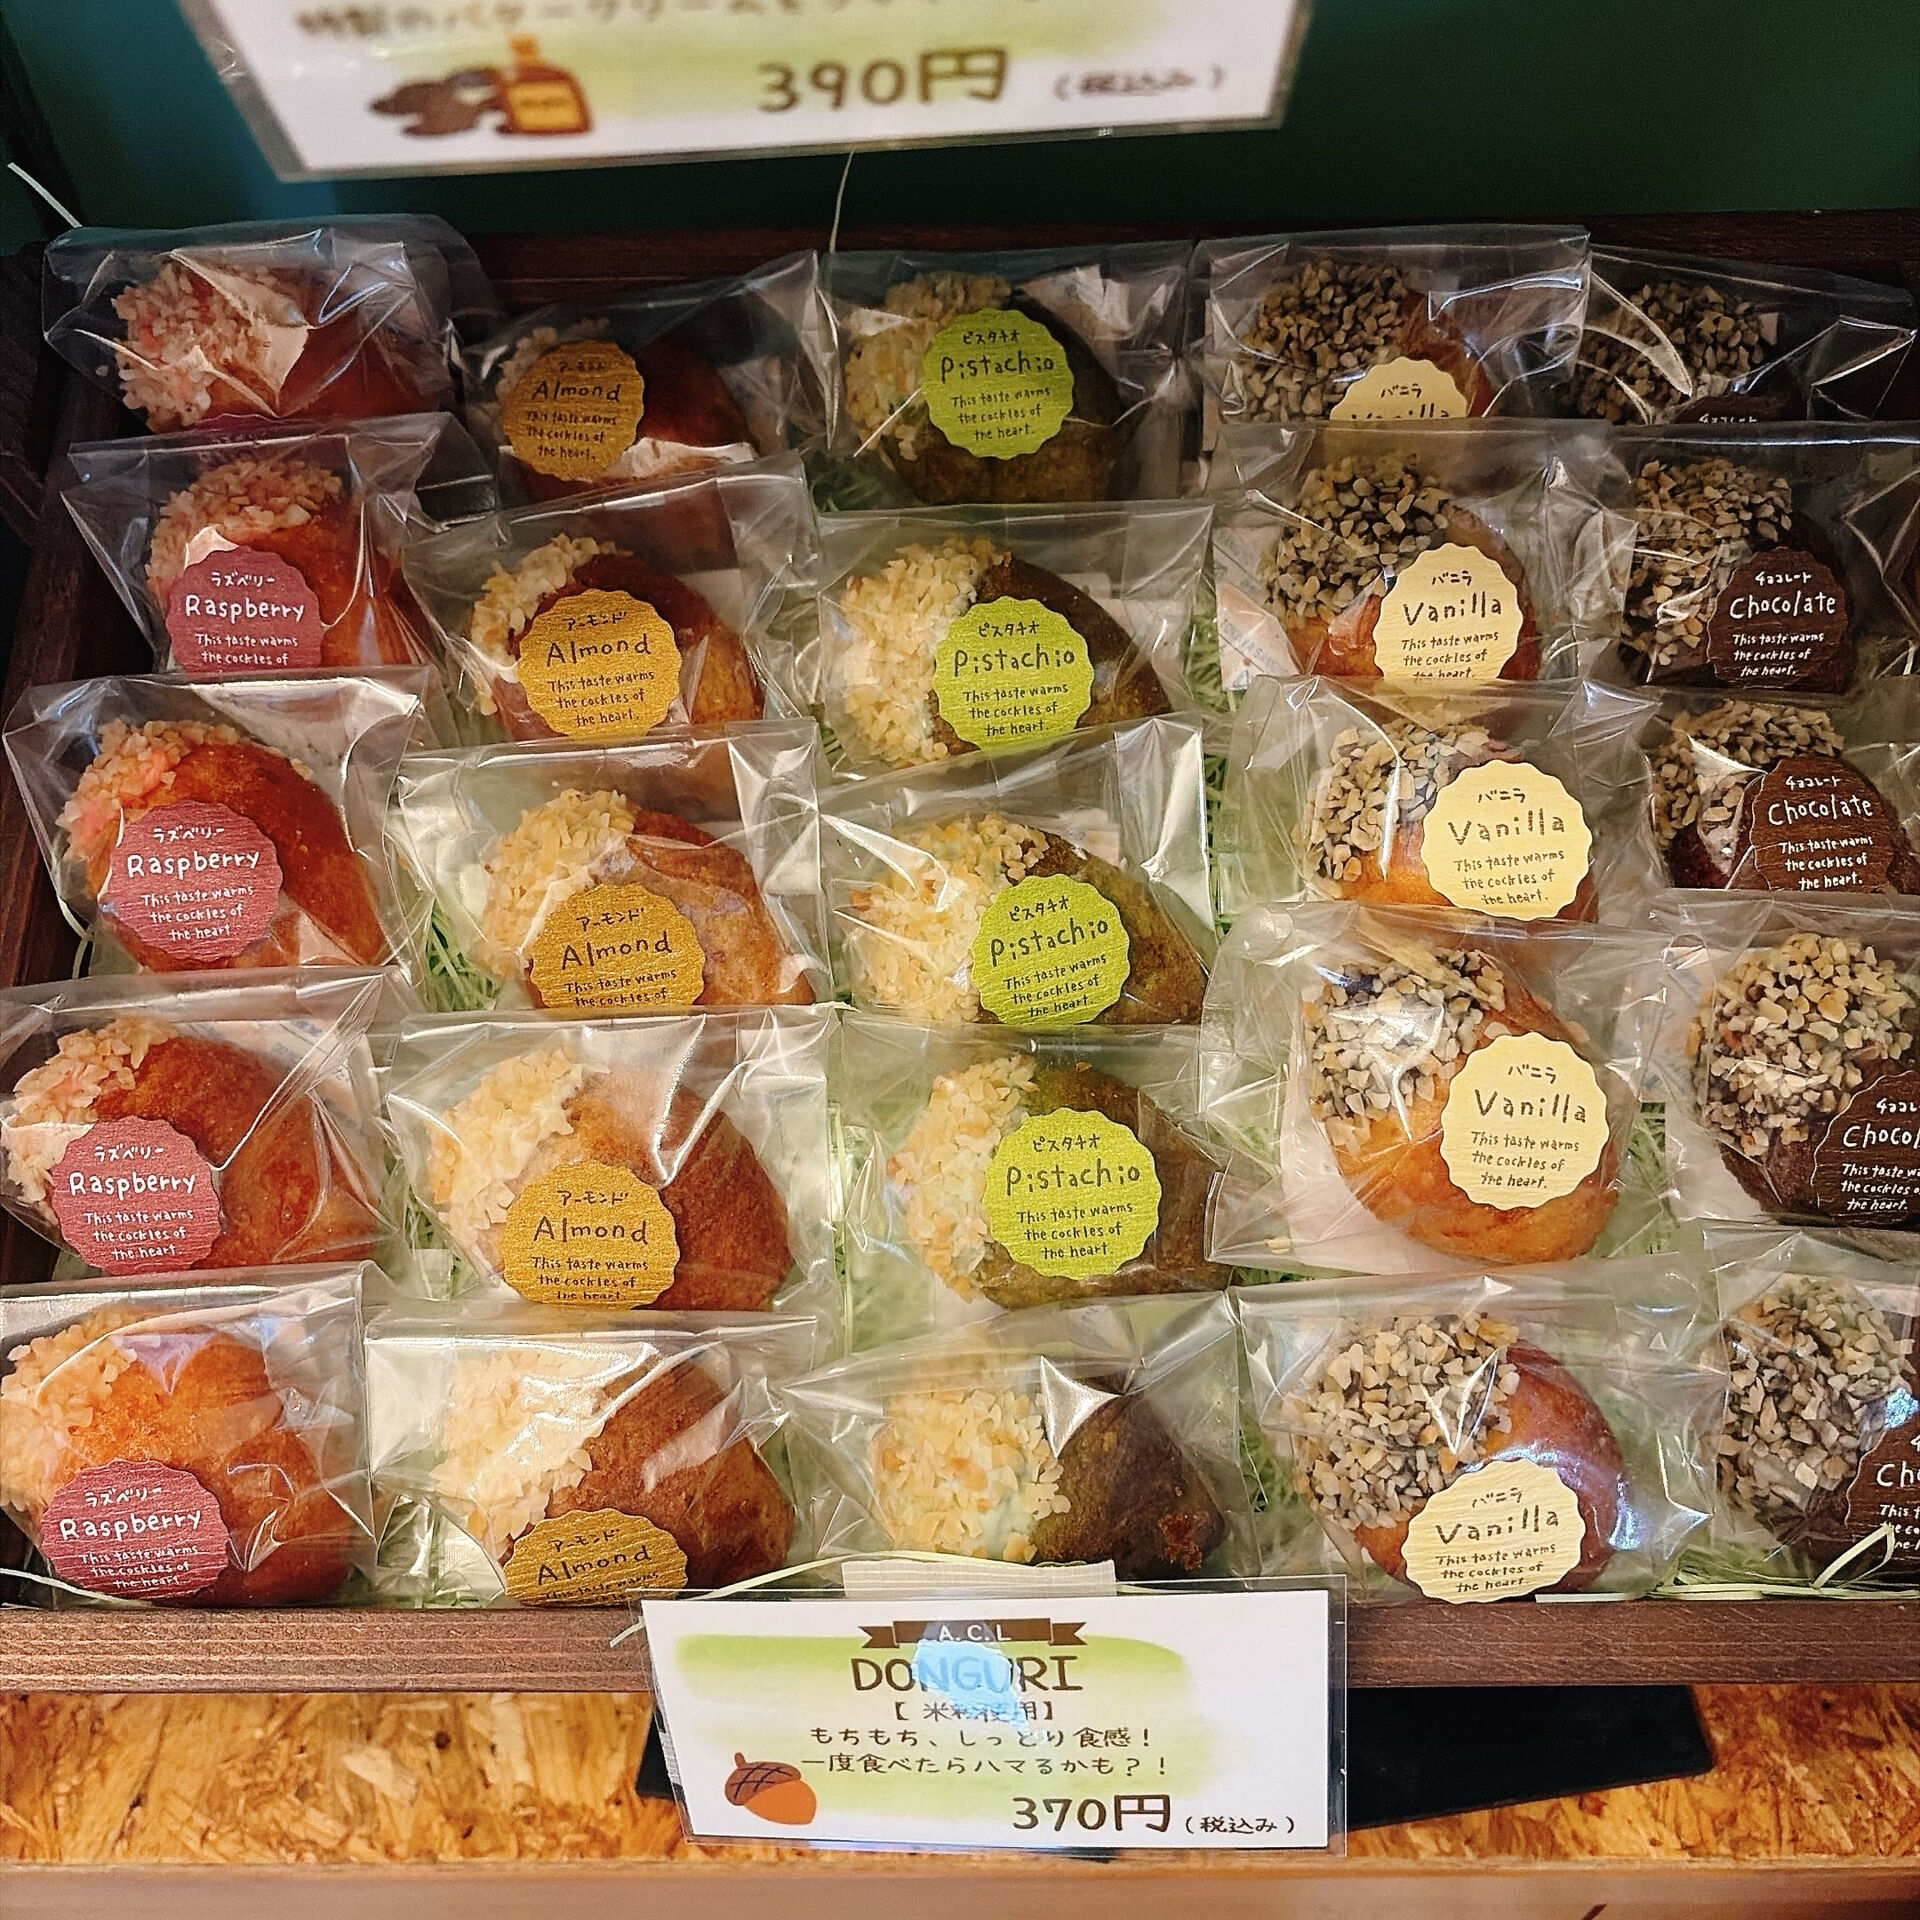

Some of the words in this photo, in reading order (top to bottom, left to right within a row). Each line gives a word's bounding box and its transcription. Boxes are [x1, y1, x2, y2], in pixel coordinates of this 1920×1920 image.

[757, 45, 1008, 113] 390円
[963, 329, 1019, 344] ピスタチオ
[941, 350, 1054, 383] Pistachio
[532, 380, 621, 401] Almond
[1381, 383, 1422, 398] バニラ
[212, 571, 276, 587] ラズベリー
[1432, 570, 1472, 586] バニラ
[186, 595, 304, 624] Raspberry
[1404, 591, 1501, 626] Vanilla
[1730, 590, 1835, 619] Chocolate
[563, 612, 627, 631] アーモンド
[979, 621, 1039, 637] ピスタチオ
[195, 634, 221, 647] This
[226, 635, 256, 647] taste
[260, 637, 298, 647] warms
[1401, 638, 1426, 650] This
[1430, 635, 1460, 648] taste
[1464, 632, 1498, 643] warms
[1733, 634, 1756, 646] This
[1760, 633, 1787, 645] taste
[1790, 633, 1824, 642] warms
[202, 651, 221, 663] the
[226, 652, 271, 665] cockles
[277, 654, 288, 665] of
[547, 633, 651, 667] Almond
[955, 643, 1075, 677] Pistachio
[1403, 656, 1422, 666] the
[1426, 652, 1471, 665] cockles
[1475, 649, 1487, 660] of
[1733, 650, 1752, 661] the
[1754, 650, 1794, 661] cockles
[1798, 648, 1811, 660] of
[1740, 665, 1758, 677] the
[548, 680, 575, 693] This
[580, 675, 611, 689] taste
[616, 671, 654, 684] warms
[556, 698, 576, 709] the
[582, 694, 628, 707] cockles
[633, 689, 645, 701] of
[963, 691, 990, 703] This
[994, 688, 1025, 700] taste
[1029, 684, 1068, 696] warms
[575, 715, 595, 726] the
[600, 709, 639, 723] heart.
[969, 708, 989, 719] the
[994, 706, 1041, 717] cockles
[1046, 702, 1058, 713] of
[985, 725, 1005, 736] the
[1011, 721, 1048, 735] heart.
[1478, 788, 1526, 803] バニラ
[1768, 794, 1872, 825] Chocolate
[153, 825, 225, 843] ラズベリー
[1448, 808, 1564, 845] Vanilla
[1779, 842, 1804, 854] This
[1807, 839, 1838, 852] taste
[1840, 836, 1873, 846] warms
[128, 850, 259, 880] Raspberry
[1453, 860, 1481, 872] This
[1486, 854, 1519, 869] taste
[1523, 851, 1564, 864] warms
[1785, 860, 1805, 871] the
[1808, 856, 1853, 870] cockles
[1856, 852, 1867, 866] of
[1462, 878, 1483, 889] the
[1488, 873, 1537, 888] cockles
[1542, 869, 1555, 881] of
[1799, 879, 1819, 890] the
[1824, 872, 1862, 888] heart.
[141, 893, 170, 907] This
[173, 890, 207, 905] taste
[212, 886, 254, 898] warms
[1481, 894, 1503, 905] the
[1507, 889, 1548, 903] heart.
[150, 911, 172, 924] the
[176, 908, 226, 922] cockles
[230, 904, 243, 917] of
[1010, 895, 1069, 922] ピスタチオ
[576, 907, 644, 931] アーモンド
[562, 930, 672, 970] Almond
[991, 917, 1108, 967] Pistachio
[565, 982, 593, 994] This
[598, 977, 631, 990] taste
[635, 970, 676, 984] warms
[1004, 978, 1030, 990] This
[1035, 967, 1065, 983] taste
[1070, 954, 1107, 973] warms
[1012, 993, 1035, 1005] the
[1037, 983, 1083, 1000] cockles
[1088, 974, 1100, 987] of
[1028, 1006, 1048, 1018] the
[1054, 995, 1095, 1012] heart.
[1508, 1064, 1556, 1084] バニラ
[1475, 1090, 1586, 1123] Vanilla
[1033, 1133, 1100, 1152] ピスタチオ
[1471, 1131, 1499, 1146] This
[1503, 1134, 1535, 1149] taste
[1540, 1140, 1579, 1151] warms
[95, 1143, 164, 1162] ラズベリー
[1472, 1151, 1492, 1165] the
[1497, 1156, 1546, 1170] cockles
[1551, 1159, 1565, 1171] of
[1007, 1158, 1140, 1196] Pistachio
[1481, 1172, 1502, 1186] the
[1507, 1175, 1548, 1188] heart.
[1842, 1164, 1868, 1176] This
[1872, 1165, 1903, 1178] taste
[70, 1171, 195, 1201] Raspberry
[1841, 1180, 1860, 1192] the
[1863, 1184, 1910, 1195] cockles
[557, 1190, 629, 1205] アーモンド
[1847, 1198, 1867, 1210] the
[1870, 1199, 1908, 1210] heart.
[84, 1212, 112, 1225] This
[115, 1212, 148, 1225] taste
[152, 1210, 193, 1220] warms
[1017, 1210, 1047, 1224] This
[1050, 1207, 1085, 1222] taste
[1090, 1202, 1132, 1216] warms
[93, 1230, 115, 1242] the
[118, 1229, 169, 1241] cockles
[174, 1227, 186, 1238] of
[533, 1216, 648, 1245] Almond
[1024, 1229, 1047, 1241] the
[1051, 1226, 1104, 1239] cockles
[1109, 1223, 1122, 1236] of
[112, 1249, 134, 1260] the
[139, 1244, 182, 1258] heart.
[1041, 1247, 1064, 1259] the
[1070, 1242, 1113, 1258] heart.
[531, 1256, 561, 1270] This
[566, 1258, 601, 1270] taste
[606, 1260, 648, 1270] warms
[85, 1487, 162, 1508] ラズベリー
[1472, 1487, 1522, 1508] バニラ
[60, 1510, 201, 1541] Raspberry
[1436, 1505, 1559, 1544] Vanilla
[538, 1545, 652, 1585] Almond
[851, 1655, 1082, 1692] DONGURI
[810, 1727, 1151, 1748] もちもち、しっとり食感！
[1012, 1794, 1171, 1833] 370円
